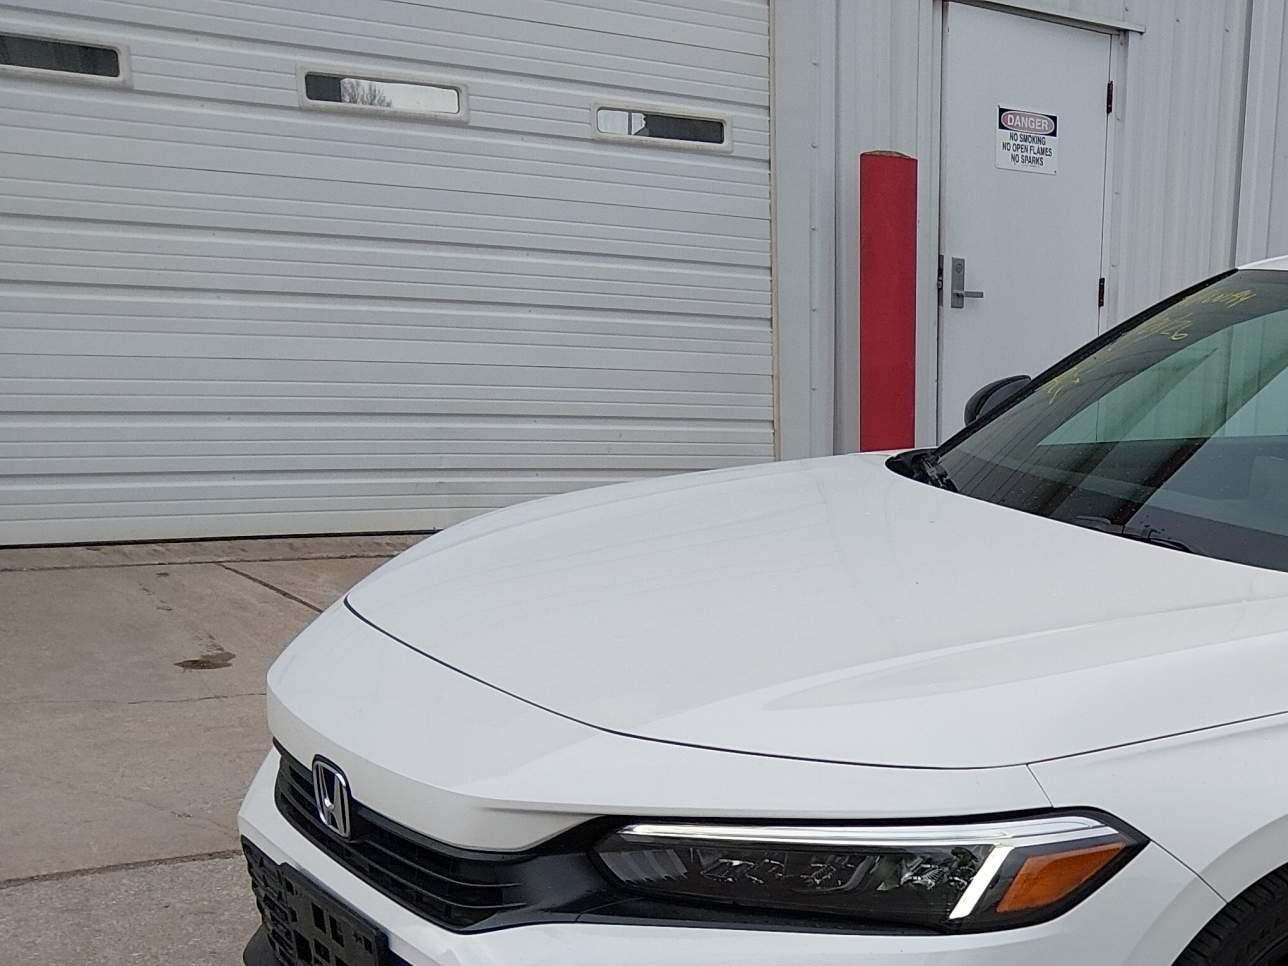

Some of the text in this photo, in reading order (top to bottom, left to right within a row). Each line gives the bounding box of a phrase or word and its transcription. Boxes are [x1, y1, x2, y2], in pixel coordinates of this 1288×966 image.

[1007, 114, 1049, 131] DANGER
[1009, 132, 1046, 146] NO SMOKING
[1002, 142, 1053, 157] NO OPEN FLAMES
[1010, 153, 1020, 163] NO
[1020, 155, 1044, 166] SPARKS
